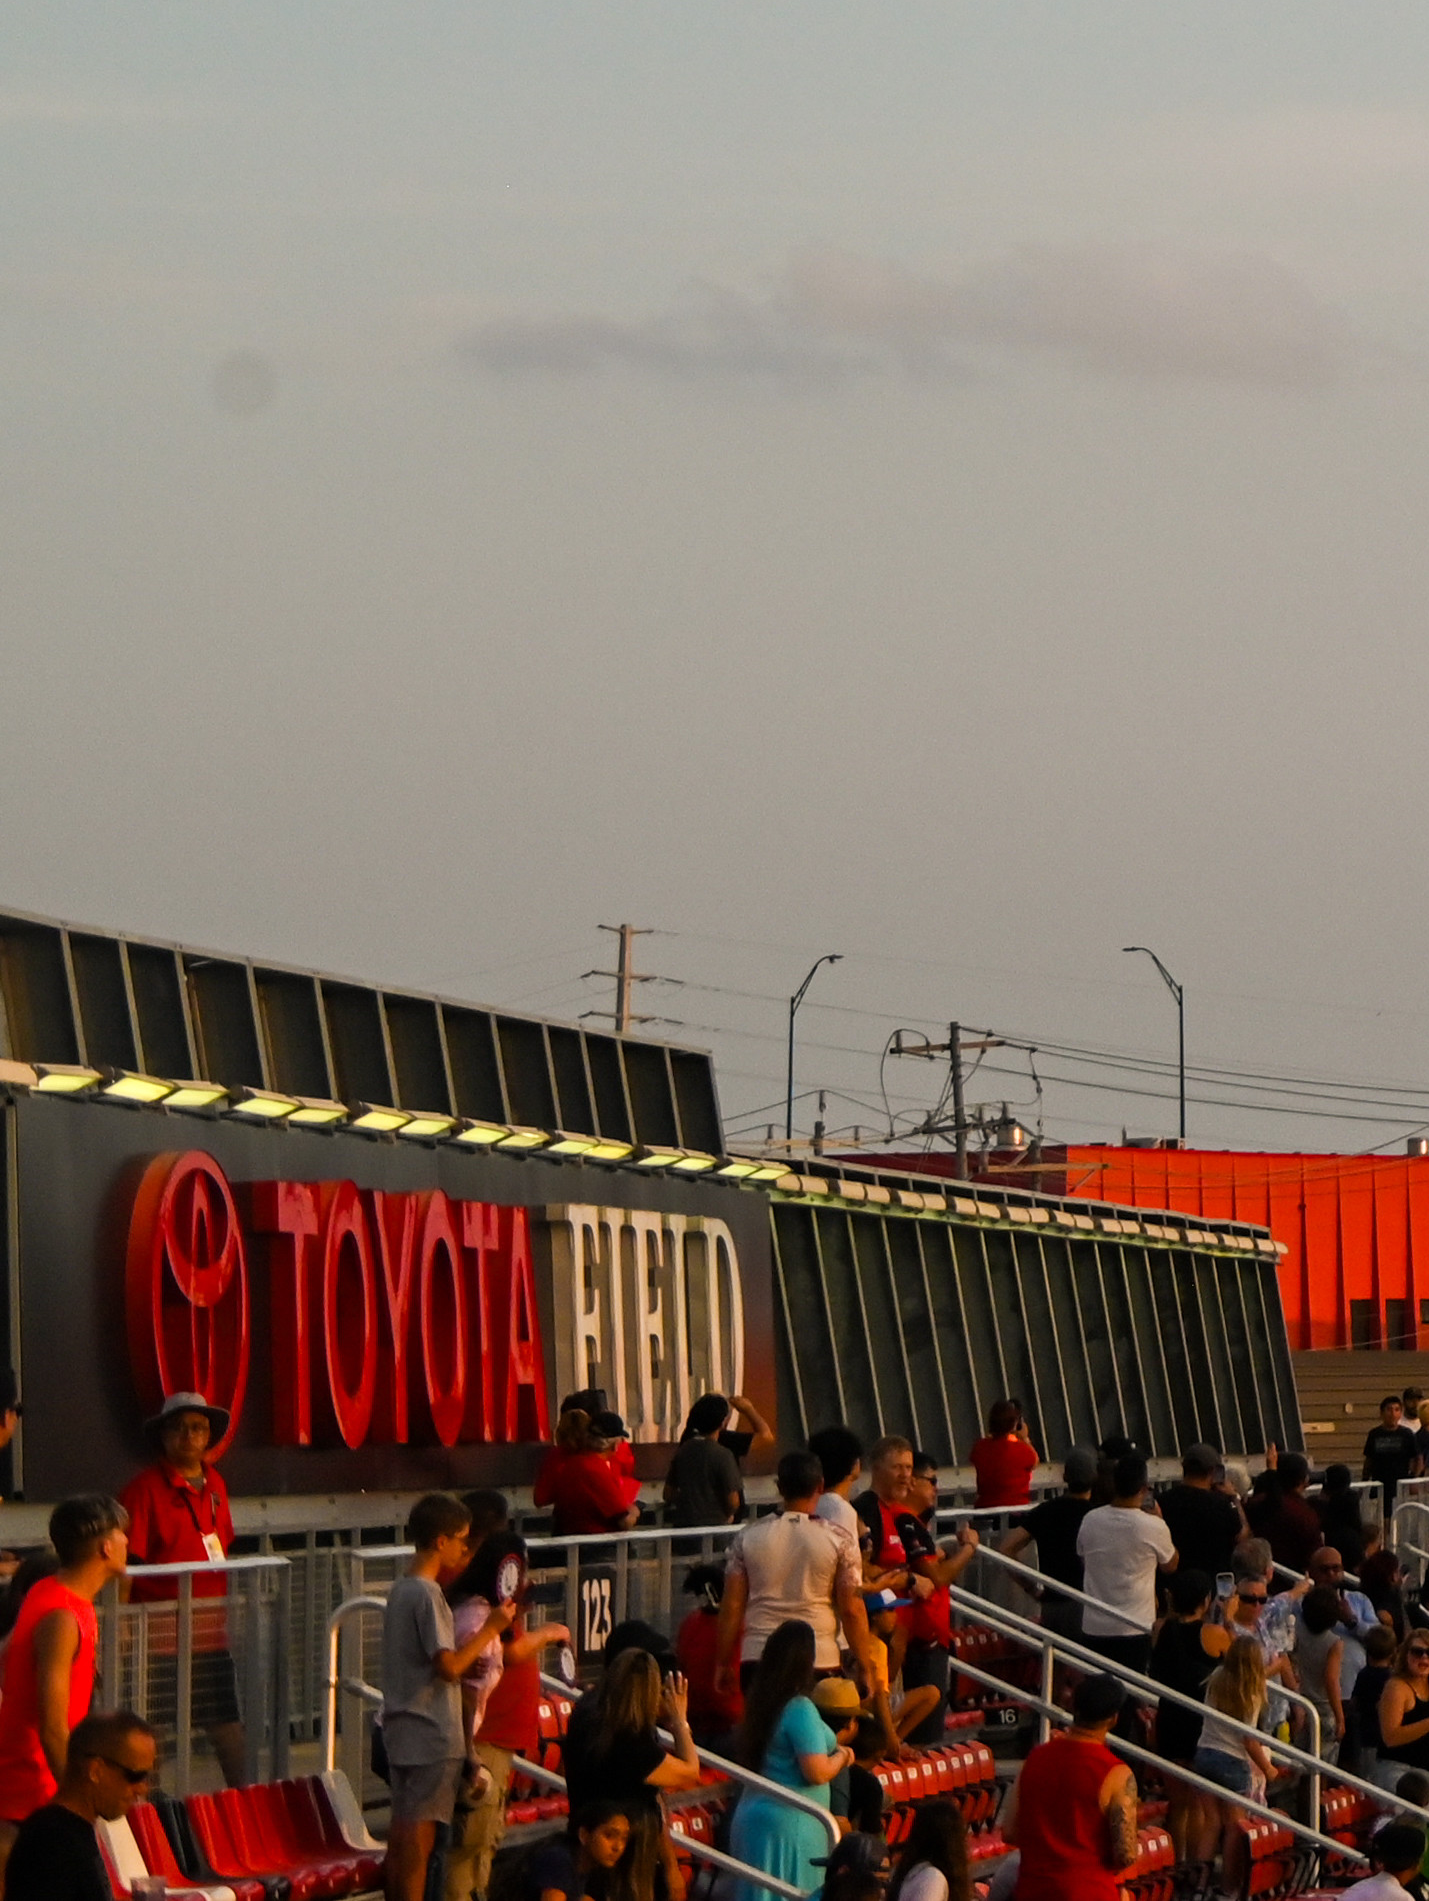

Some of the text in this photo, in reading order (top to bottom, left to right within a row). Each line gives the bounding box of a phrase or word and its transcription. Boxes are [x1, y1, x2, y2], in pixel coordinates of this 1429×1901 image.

[252, 1179, 745, 1450] TOYOTA FIELD
[582, 1578, 612, 1652] 123
[999, 1708, 1017, 1724] 16
